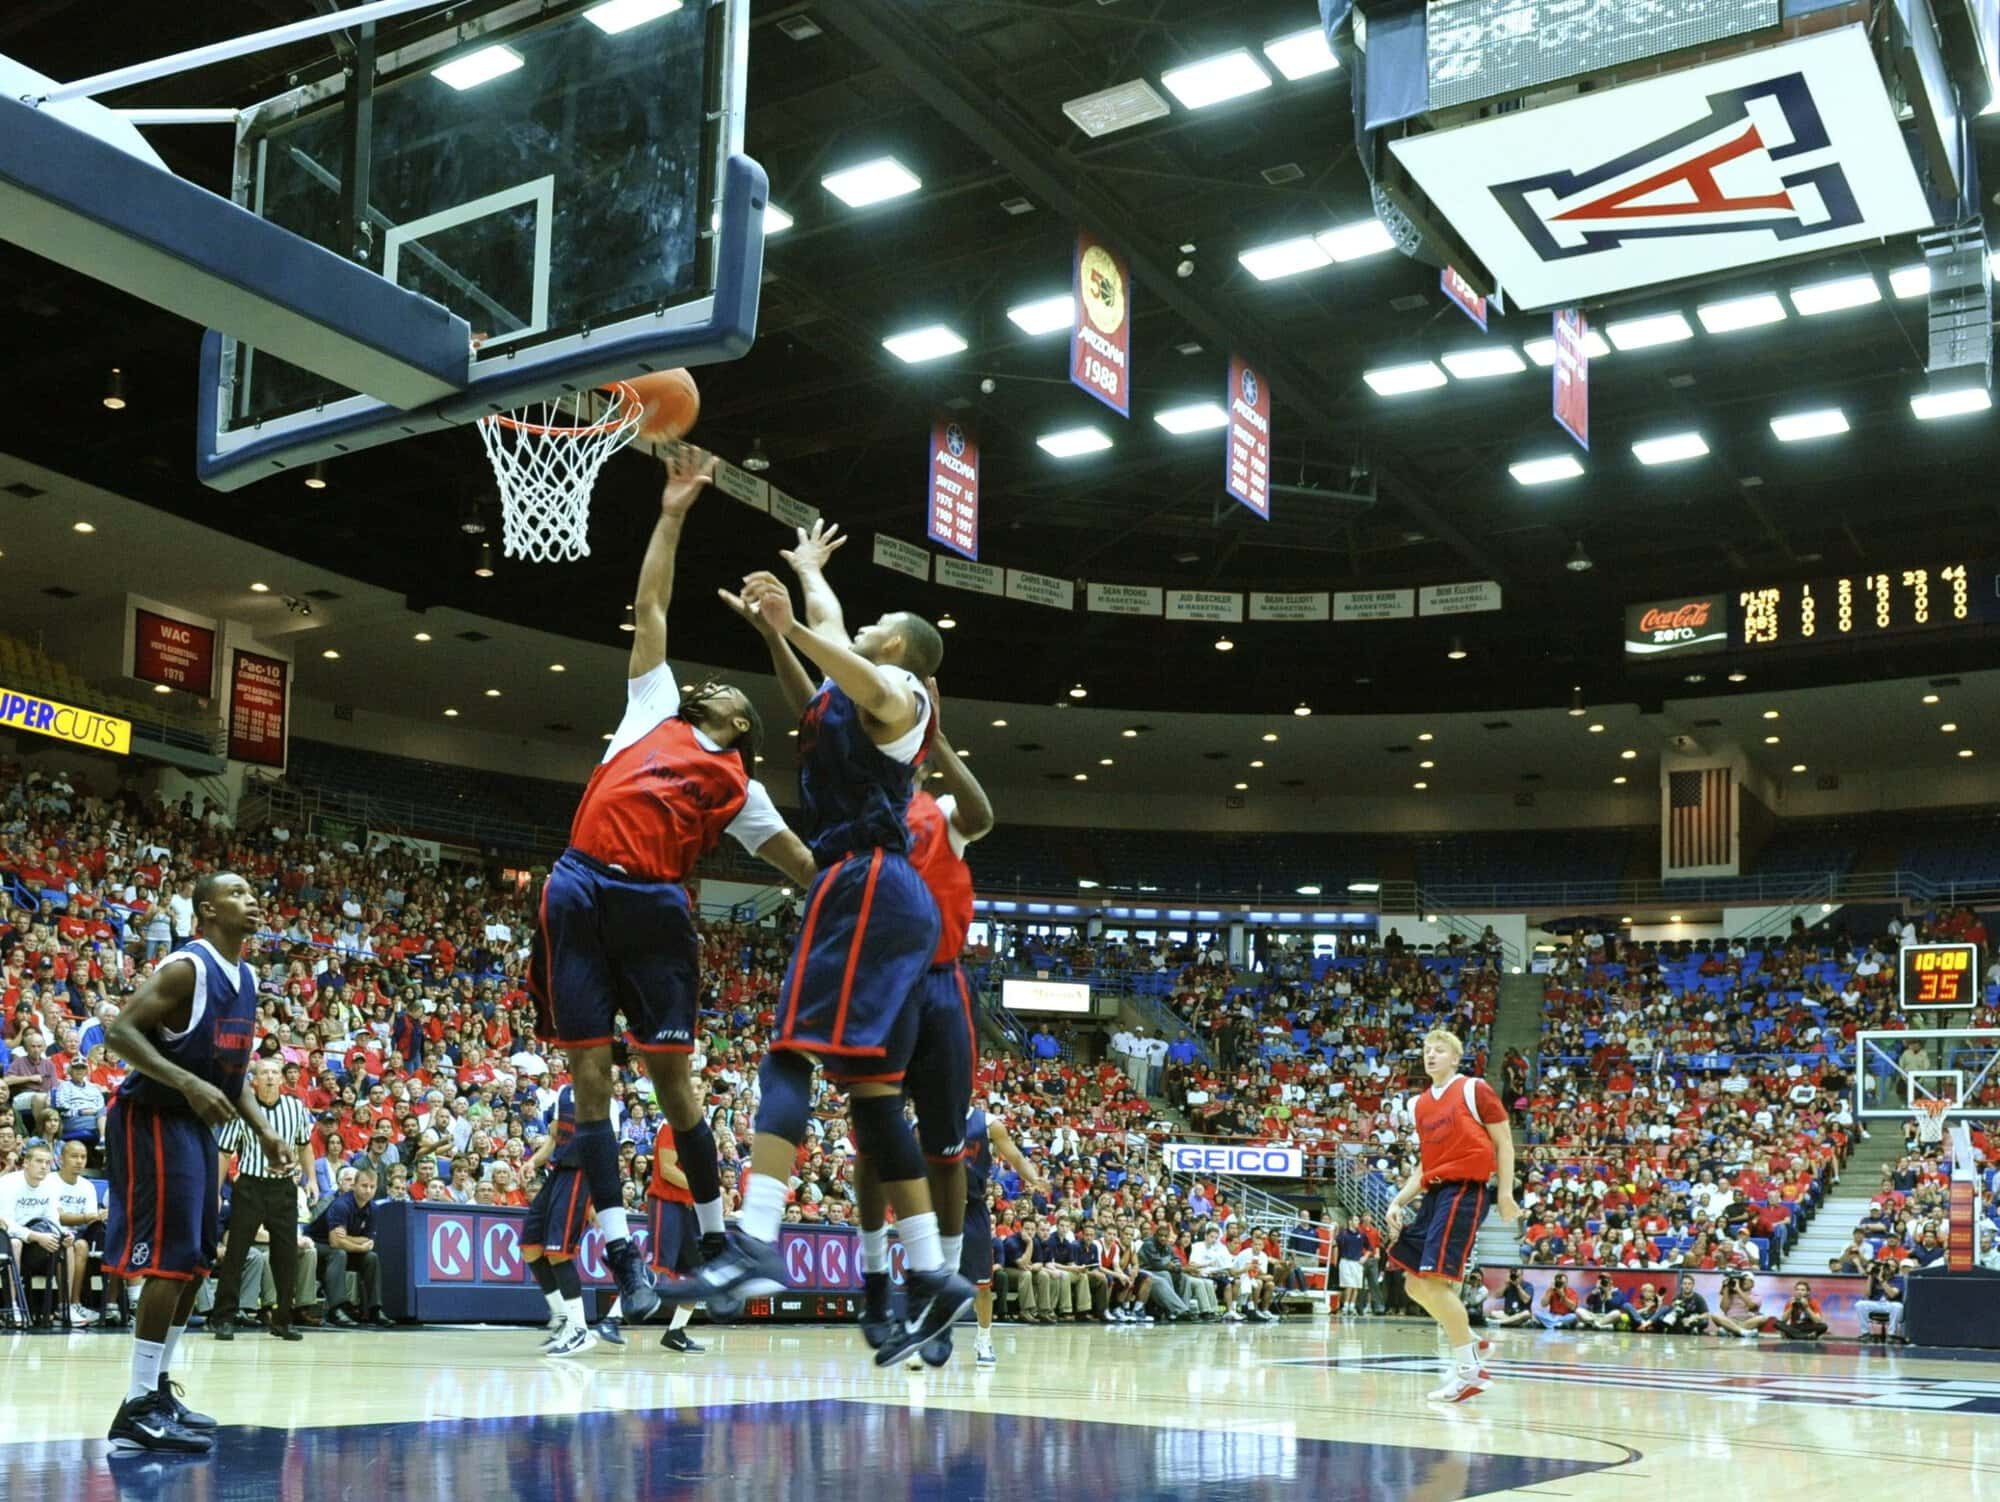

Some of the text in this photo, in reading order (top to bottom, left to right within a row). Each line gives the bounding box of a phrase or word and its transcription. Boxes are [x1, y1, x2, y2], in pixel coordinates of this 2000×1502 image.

[1078, 326, 1124, 368] ARIZONA
[1084, 356, 1118, 395] 1988
[1232, 398, 1267, 433] ARIZONA
[936, 450, 975, 480] ARIZONA
[936, 475, 962, 496] SWEET
[1802, 596, 1814, 610] 0
[1839, 593, 1851, 606] 0
[1877, 588, 1889, 601] 0
[1915, 583, 1928, 596] 0
[1954, 579, 1966, 592] 0
[1803, 584, 1809, 596] 1
[1839, 579, 1851, 593] 2
[1866, 574, 1889, 590] 12
[1902, 569, 1927, 586] 33
[1941, 564, 1966, 581] 44
[1802, 610, 1815, 623] 0
[1839, 606, 1851, 619] 0
[1877, 601, 1889, 614] 0
[1915, 597, 1928, 610] 0
[1954, 592, 1967, 605] 0
[160, 624, 191, 645] WAC
[240, 658, 280, 677] Pac-10
[1918, 974, 1959, 1000] 35
[1177, 1148, 1289, 1173] GEICO
